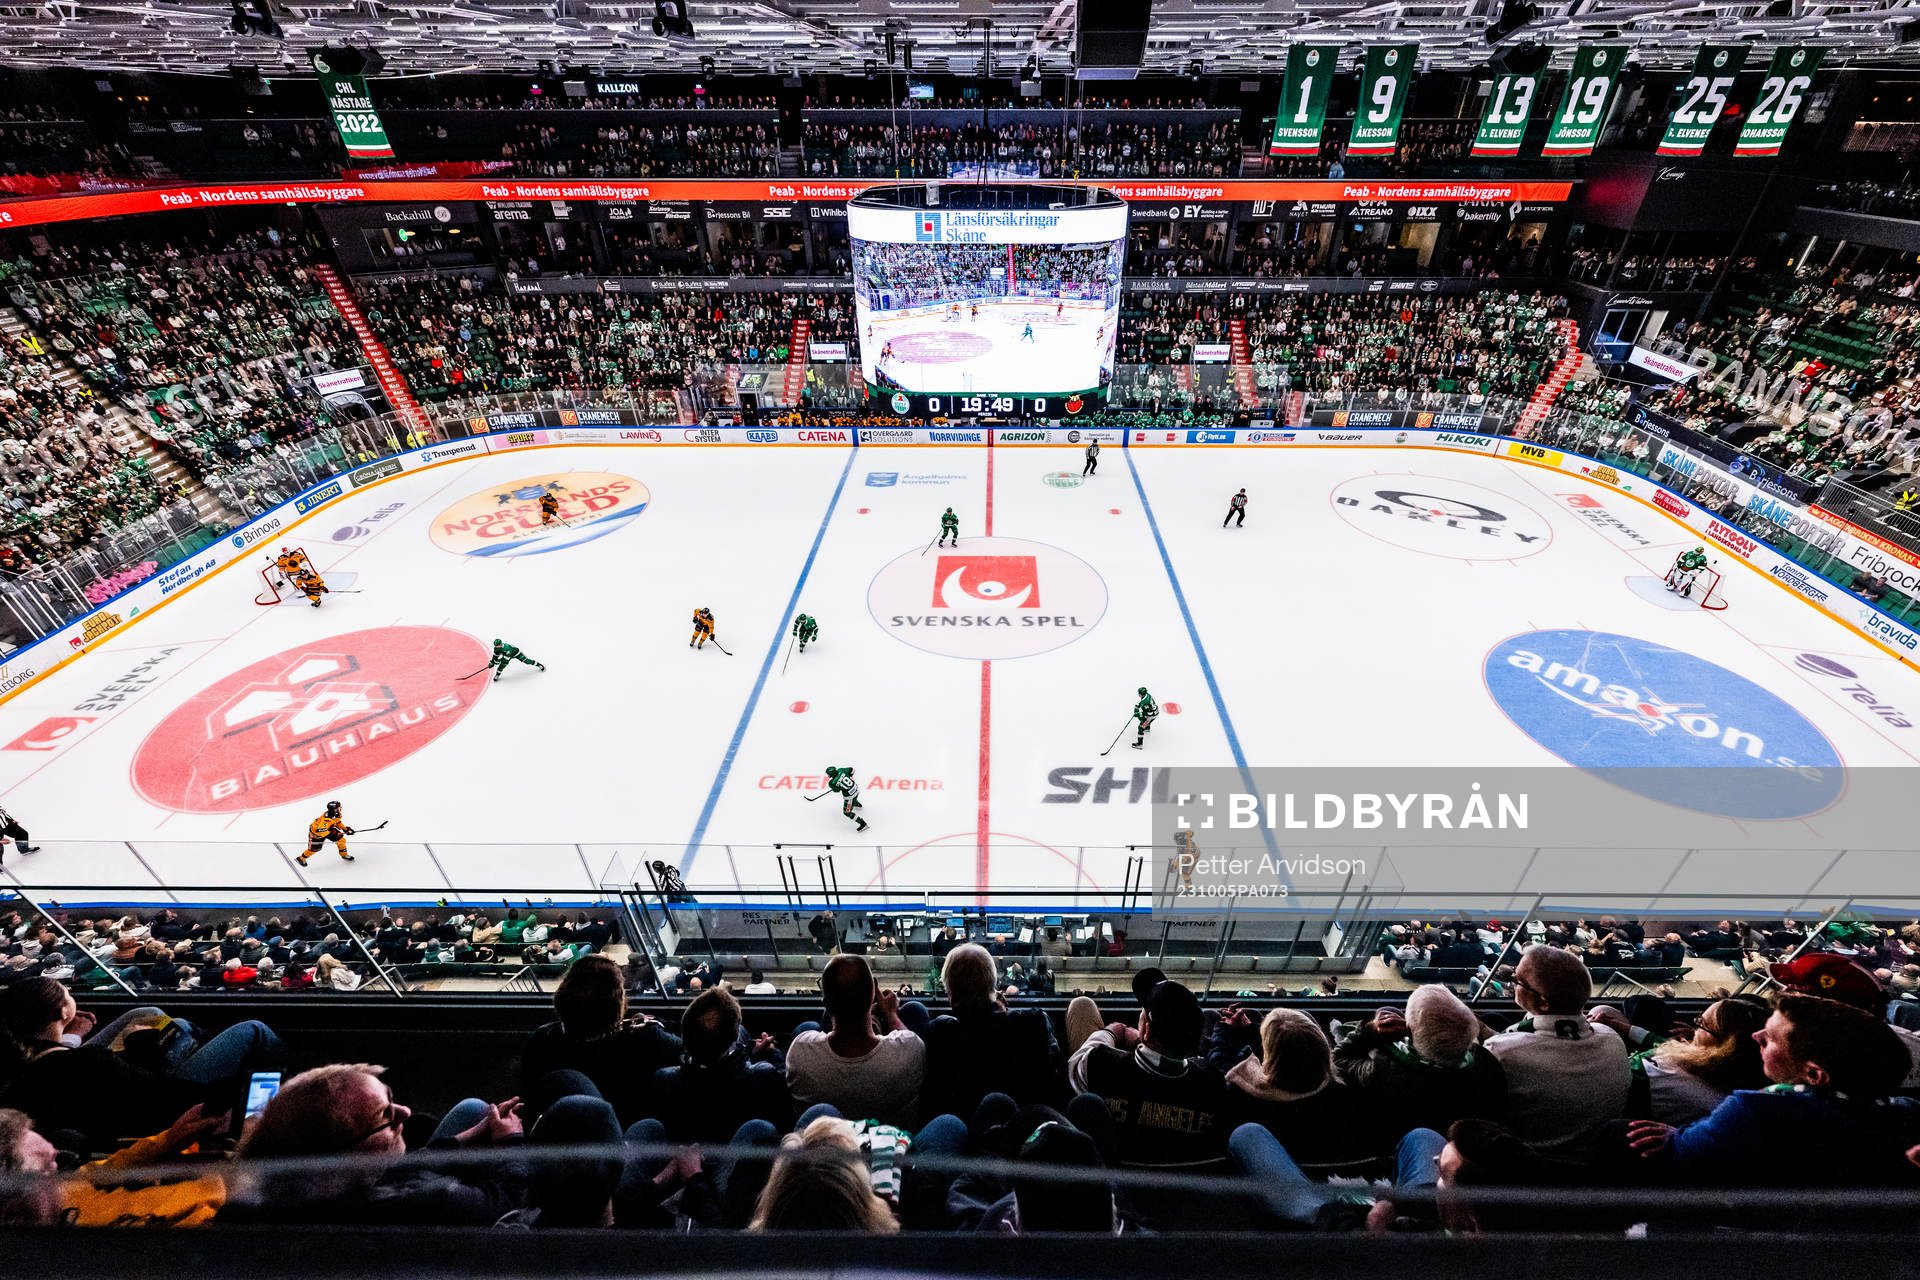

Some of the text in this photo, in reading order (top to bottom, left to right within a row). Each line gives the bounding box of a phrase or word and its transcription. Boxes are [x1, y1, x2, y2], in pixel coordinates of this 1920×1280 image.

[335, 82, 356, 93] CHL
[597, 84, 639, 93] KALLZON
[1294, 76, 1313, 123] 1
[1368, 76, 1397, 123] 9
[1487, 77, 1535, 124] 13
[1560, 76, 1611, 123] 19
[1672, 77, 1735, 123] 25
[1748, 76, 1811, 123] 26
[337, 114, 382, 133] 2022
[1356, 125, 1393, 138] ÅKESSON
[1278, 127, 1318, 138] SVENSSON
[160, 186, 364, 205] Peab Nordens samhällsbyggare
[483, 185, 649, 199] Peab Nordens samhällsbyggare
[769, 186, 795, 196] Peab
[803, 186, 846, 196] Nordens
[1135, 185, 1223, 200] samhällsbyggare
[1343, 186, 1511, 199] Peab Nordens samhällsbyggare
[385, 210, 432, 222] Backahill
[494, 210, 529, 220] arema
[763, 207, 792, 218] SSE
[1132, 208, 1168, 217] Swedbank
[1184, 205, 1202, 218] EY
[1464, 212, 1501, 223] bakertilly
[946, 211, 1060, 230] Länsförsäkringar
[946, 228, 987, 242] Skåne
[1643, 356, 1683, 377] Skånetrafiken
[318, 375, 361, 389] Skånetrafiken
[929, 398, 940, 412] 0
[961, 397, 1013, 412] 19:49
[1034, 398, 1046, 412] 0
[488, 413, 535, 427] CRANEMECH
[577, 411, 620, 421] CRANEMECH
[1349, 412, 1392, 422] CRANEMECH
[1433, 414, 1481, 428] CRANEMECH
[507, 432, 534, 443] SPORT
[749, 432, 775, 440] KAABS
[798, 431, 846, 441] CATENA
[929, 431, 982, 442] NORRVIDINGE
[1000, 432, 1046, 441] AGRIZON
[432, 443, 476, 459] Tranpenad
[1521, 445, 1546, 458] MVB
[1589, 469, 1621, 485] JACKPOT
[1597, 465, 1617, 476] EURO
[307, 484, 340, 507] JINERT
[361, 501, 405, 526] Telia
[442, 481, 632, 537] NORRANDS
[1337, 496, 1539, 544] OAKLEY
[1577, 509, 1606, 528] SPEL
[1592, 507, 1651, 546] SVENSKA
[243, 517, 281, 544] Brinova
[1708, 520, 1758, 553] FLYTGOLV
[1707, 530, 1742, 554] LANDSKRONA
[1879, 542, 1915, 563] KRONAN
[158, 564, 192, 587] Stefan
[1781, 562, 1810, 581] Tommy
[162, 565, 205, 595] Nordbergh
[1770, 565, 1828, 602] NORDBERGHS
[82, 611, 110, 631] EURO
[83, 614, 123, 643] JACKPOT
[890, 615, 1085, 628] SVENSKA SPEL
[1867, 613, 1918, 650] bravida
[74, 647, 182, 711] SVENSKA
[98, 675, 158, 712] SPEL
[1840, 683, 1913, 729] Telia
[1506, 649, 1826, 783] amazon.se
[211, 692, 466, 800] BAUHAUS
[758, 775, 944, 790] CATEN Arena
[1041, 767, 1198, 805] SHL
